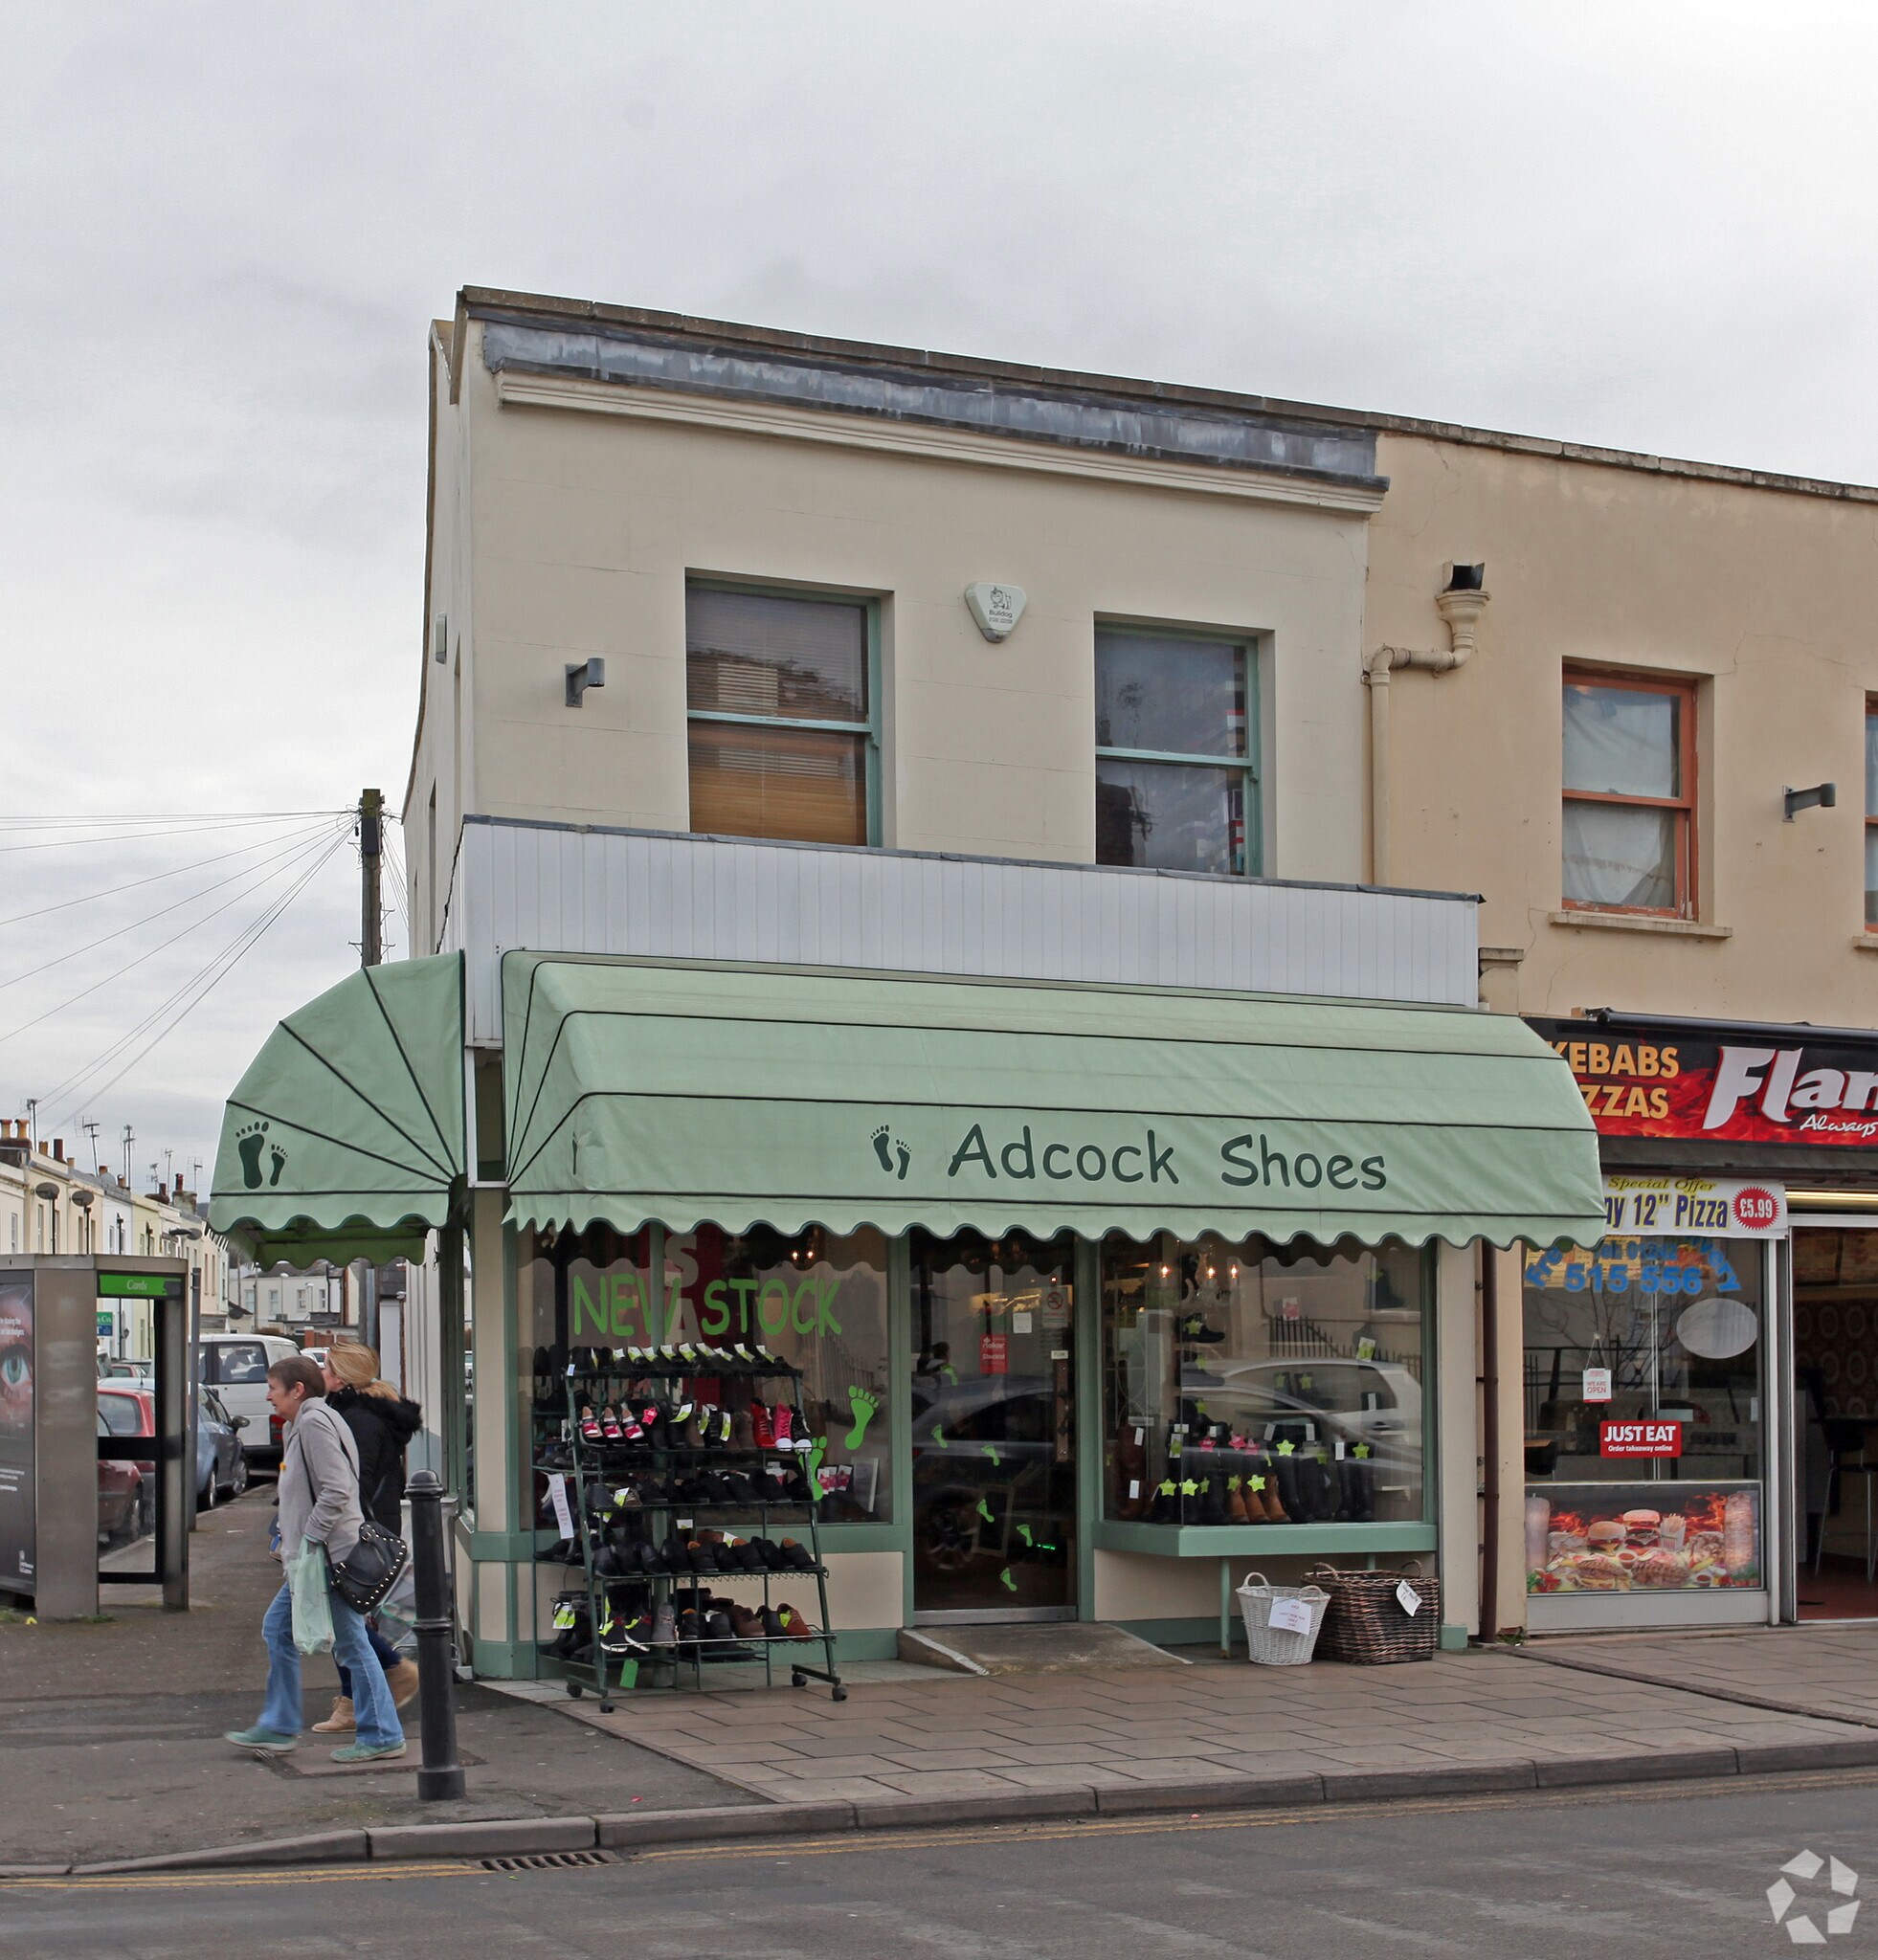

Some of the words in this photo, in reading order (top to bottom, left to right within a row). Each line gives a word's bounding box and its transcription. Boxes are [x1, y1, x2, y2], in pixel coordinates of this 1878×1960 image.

[989, 610, 1013, 618] Bulldog
[1579, 1084, 1669, 1120] ZZAS
[1800, 1114, 1878, 1138] Always
[947, 1123, 1179, 1185] Adcock
[1220, 1133, 1388, 1192] Shoes
[1608, 1175, 1669, 1191] Special
[1675, 1176, 1717, 1192] Offer
[1604, 1196, 1626, 1228] ny
[1675, 1194, 1728, 1228] Pizza
[1739, 1197, 1774, 1219] £5.99
[1524, 1245, 1563, 1290] Fre
[1564, 1262, 1629, 1293] 515
[1640, 1264, 1703, 1295] 556
[126, 1279, 147, 1291] Cards
[701, 1278, 842, 1337] STOCK
[1604, 1426, 1643, 1442] JUST
[1646, 1426, 1676, 1441] EAT
